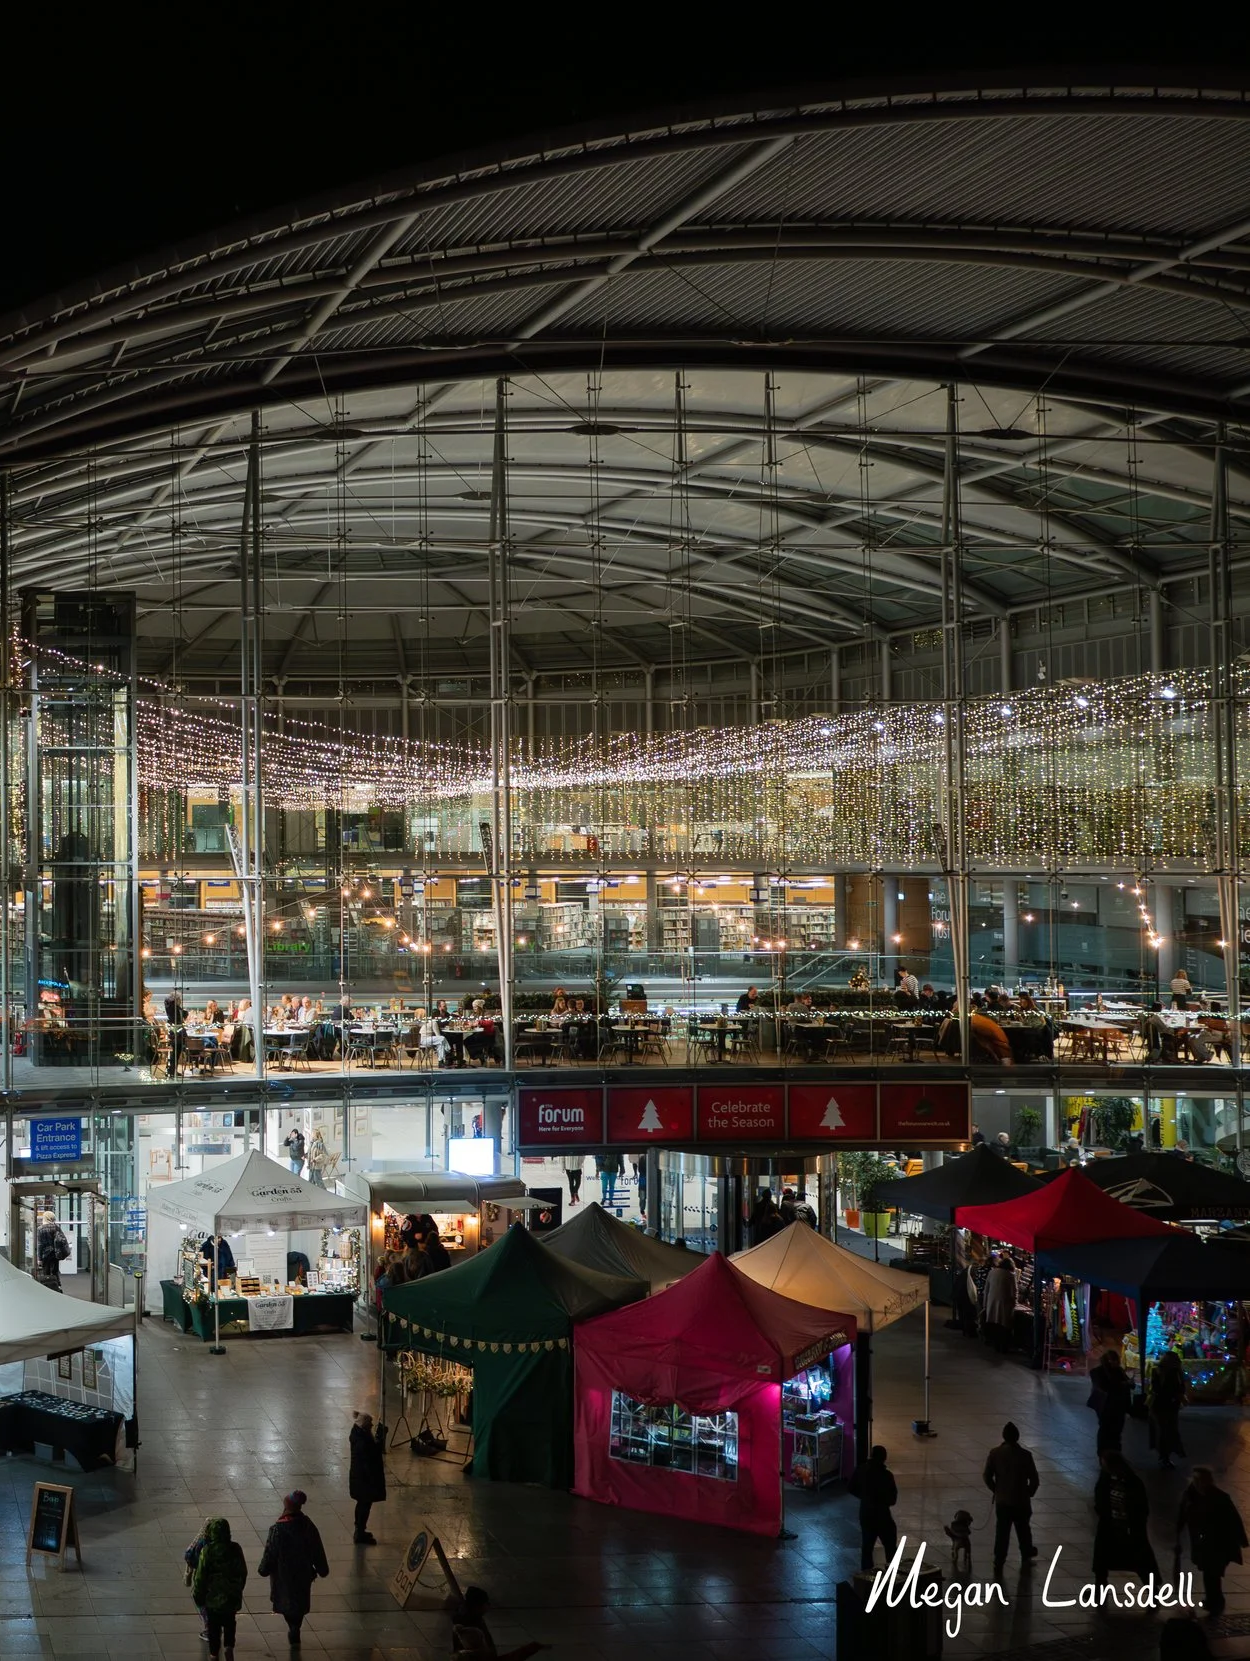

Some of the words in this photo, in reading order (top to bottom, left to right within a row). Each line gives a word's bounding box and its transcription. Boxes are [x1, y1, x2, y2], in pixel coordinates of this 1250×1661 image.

[931, 906, 951, 922] Foru
[711, 1100, 771, 1113] Celebrate
[538, 1104, 584, 1123] forum
[37, 1123, 54, 1132] Car
[55, 1122, 76, 1131] Park
[708, 1116, 729, 1128] the
[732, 1116, 775, 1128] Season
[36, 1134, 76, 1143] Entrance
[251, 1188, 288, 1197] Garden
[255, 1301, 278, 1309] Garden
